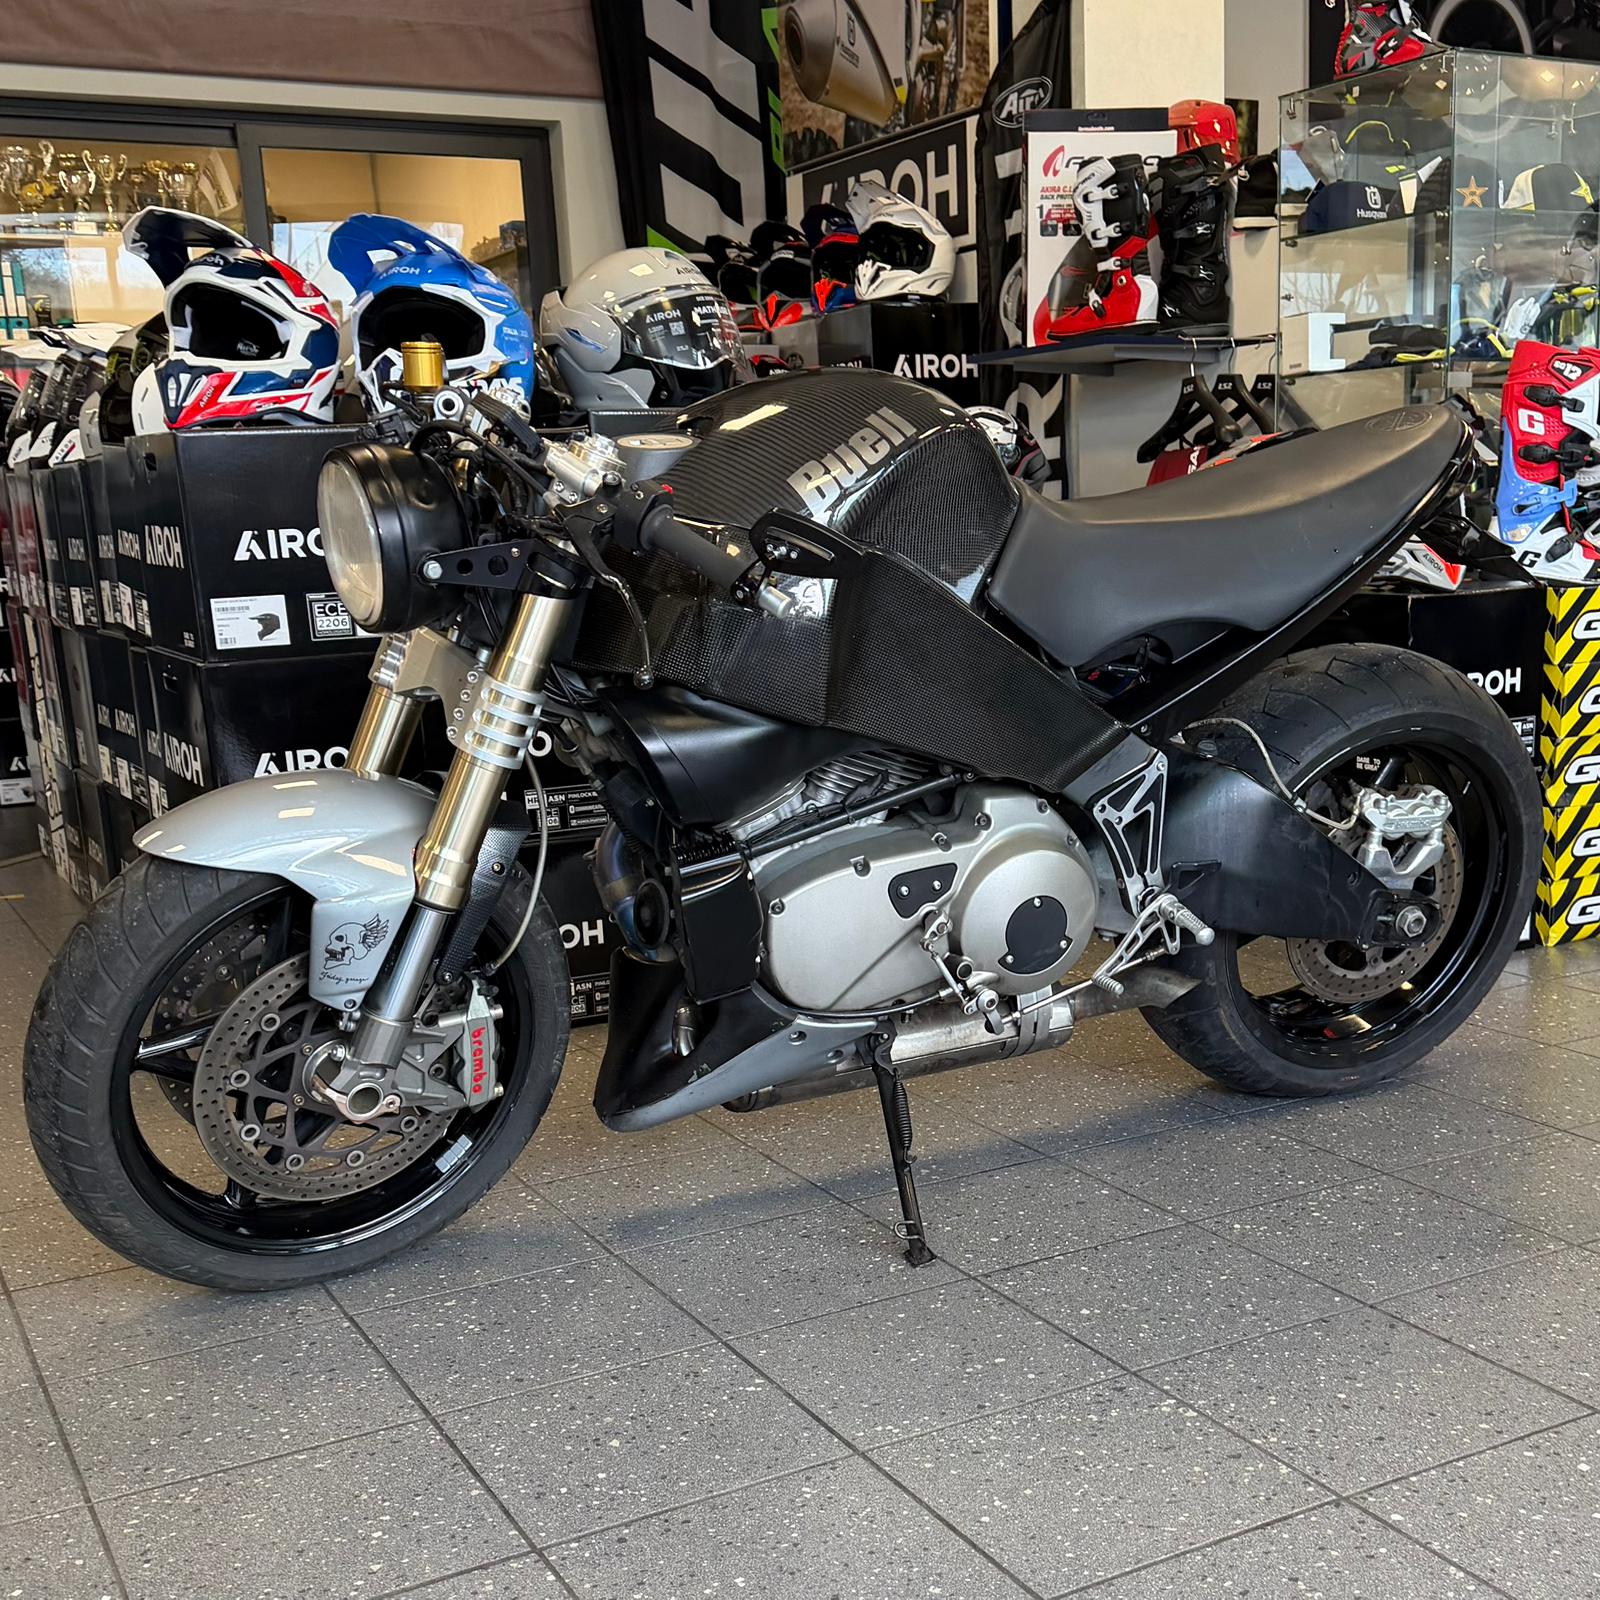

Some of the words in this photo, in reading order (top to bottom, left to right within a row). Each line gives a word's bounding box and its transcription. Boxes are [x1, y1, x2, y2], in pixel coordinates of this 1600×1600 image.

[645, 309, 681, 324] AIROH
[893, 353, 979, 379] AIROH
[786, 406, 917, 524] Buell
[117, 529, 141, 560] AIROH
[144, 525, 184, 569] AIROH
[1423, 551, 1444, 574] AIROH
[315, 603, 348, 617] ECE
[318, 618, 348, 629] 2206
[163, 732, 204, 787] AIROH
[548, 794, 565, 803] ASN
[575, 982, 592, 992] ASN
[471, 1027, 487, 1094] brembo
